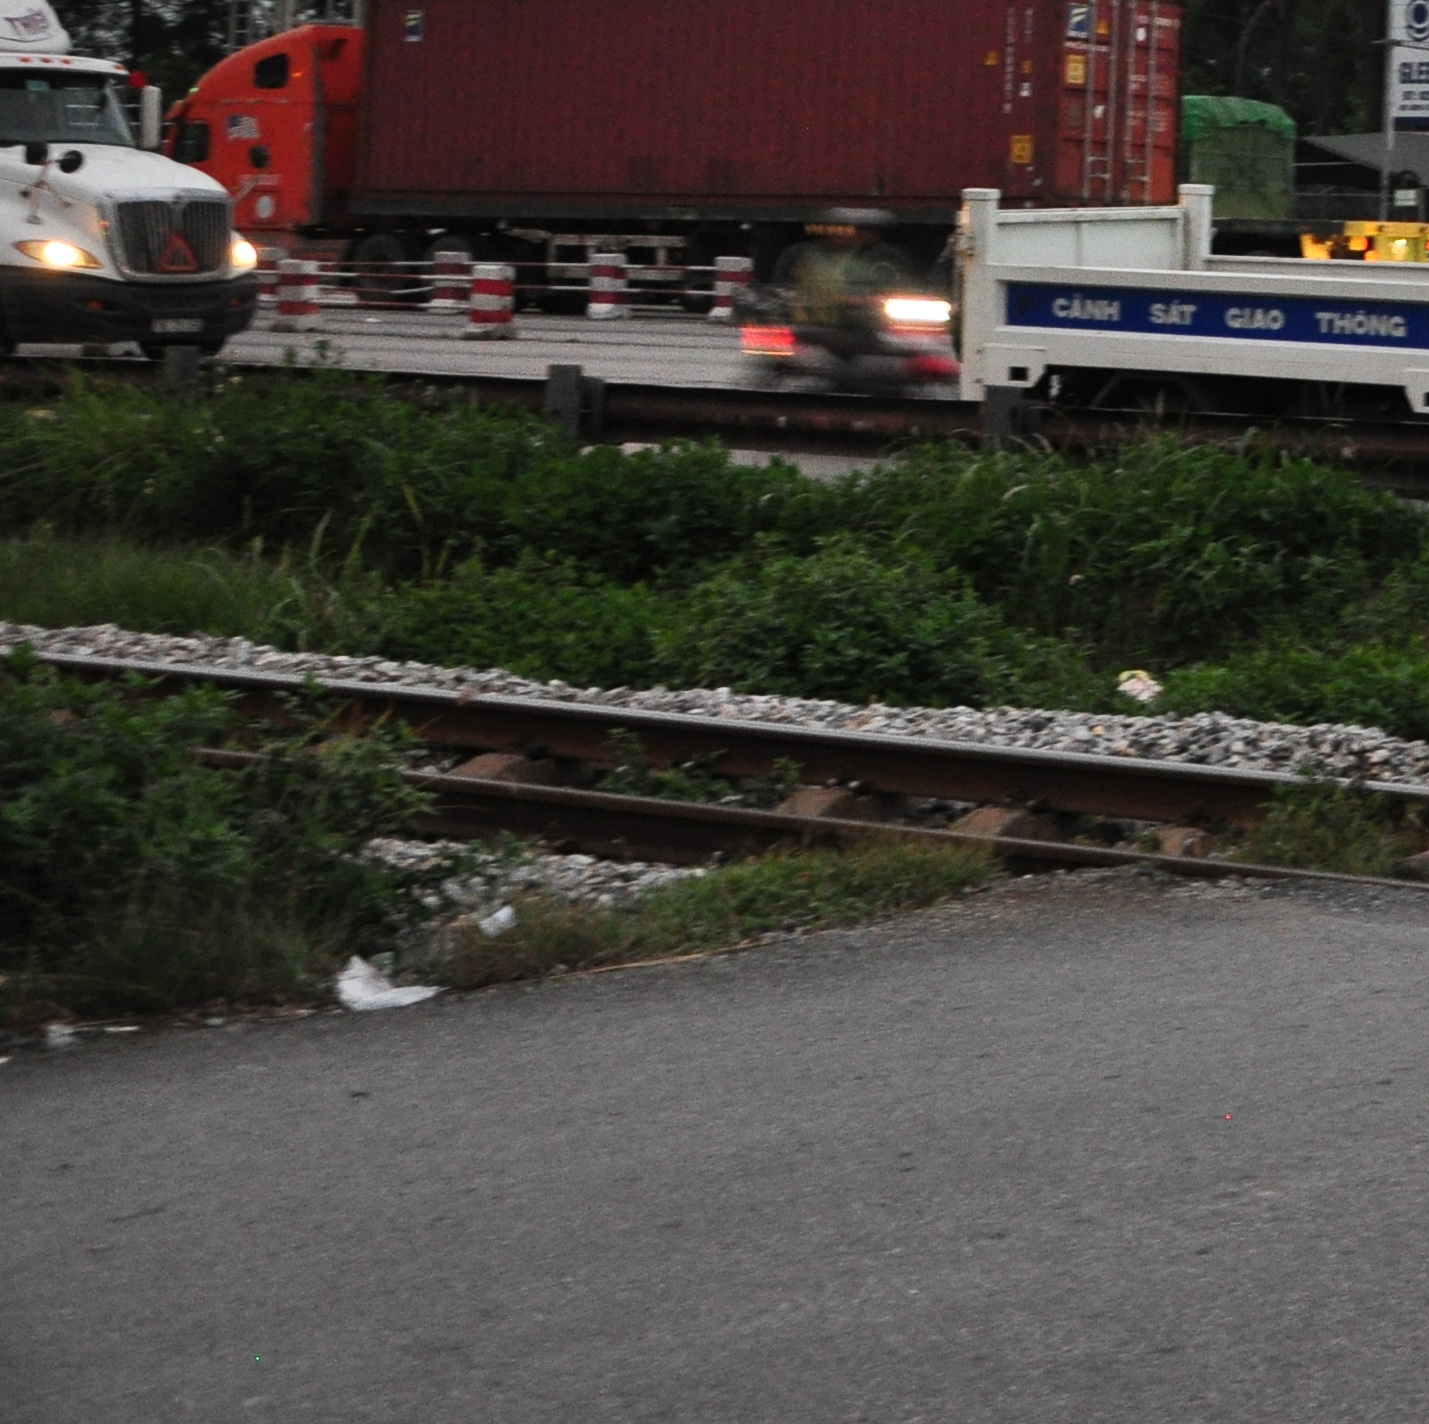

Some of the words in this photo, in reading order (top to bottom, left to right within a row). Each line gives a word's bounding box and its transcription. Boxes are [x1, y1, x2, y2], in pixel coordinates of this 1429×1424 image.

[1149, 299, 1197, 326] SÁT
[1224, 307, 1286, 331] GIAO
[1314, 310, 1407, 337] THÔNG
